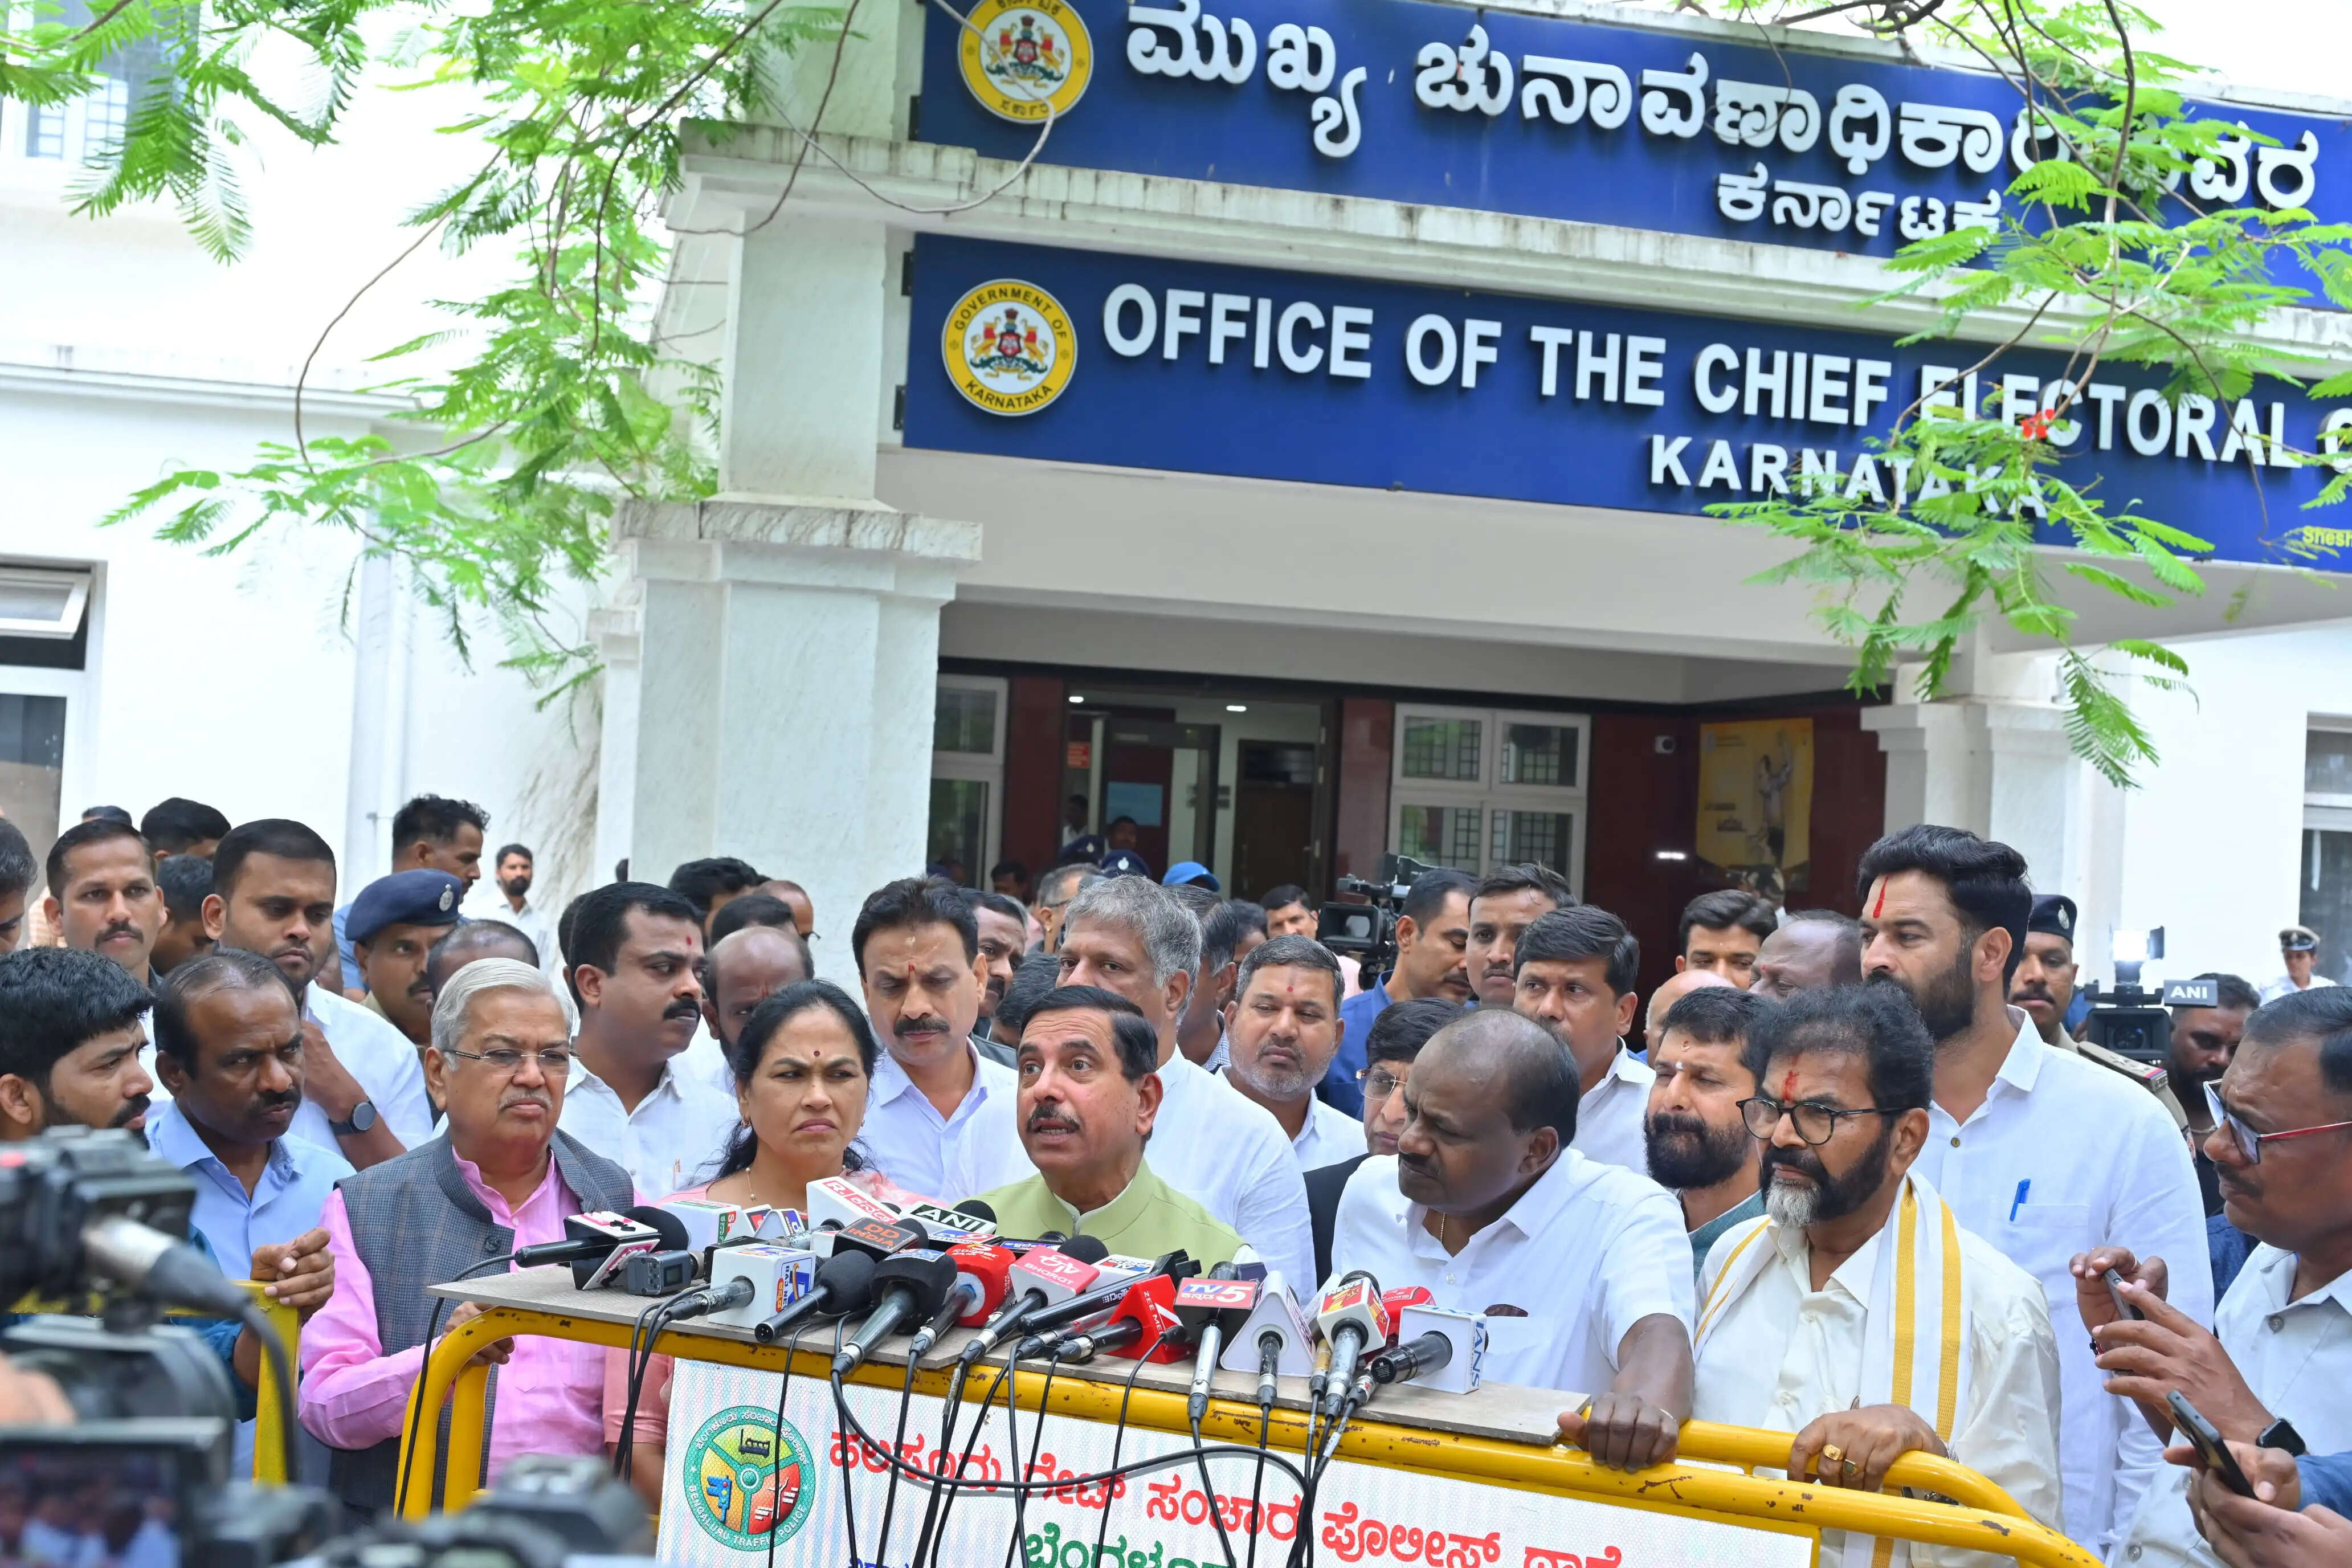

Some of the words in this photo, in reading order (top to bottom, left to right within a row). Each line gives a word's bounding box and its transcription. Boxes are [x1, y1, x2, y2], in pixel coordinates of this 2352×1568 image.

[1126, 0, 1367, 157] ಮುಖ್ಯ
[1717, 161, 2002, 240] ಕರ್ನಾಟಕ
[954, 287, 1052, 330] GOVERNMENT
[1052, 318, 1067, 338] OF
[1104, 283, 1374, 379] OFFICE
[1406, 313, 1502, 389] OF
[1529, 325, 1666, 406] THE
[1694, 342, 1892, 427] CHIEF
[965, 380, 1052, 409] KARNATAKA
[2170, 985, 2208, 999] ANI
[848, 1227, 894, 1247] INDIA
[864, 1223, 901, 1239] DD
[915, 1208, 982, 1232] ANI
[1144, 1291, 1155, 1312] ZEE
[1472, 1321, 1484, 1387] IANS
[688, 1485, 730, 1540] BENGALURU
[1146, 1473, 1302, 1541] ಸಂಚಾರ
[1322, 1501, 1500, 1568] ಪೊಲೀಸ್
